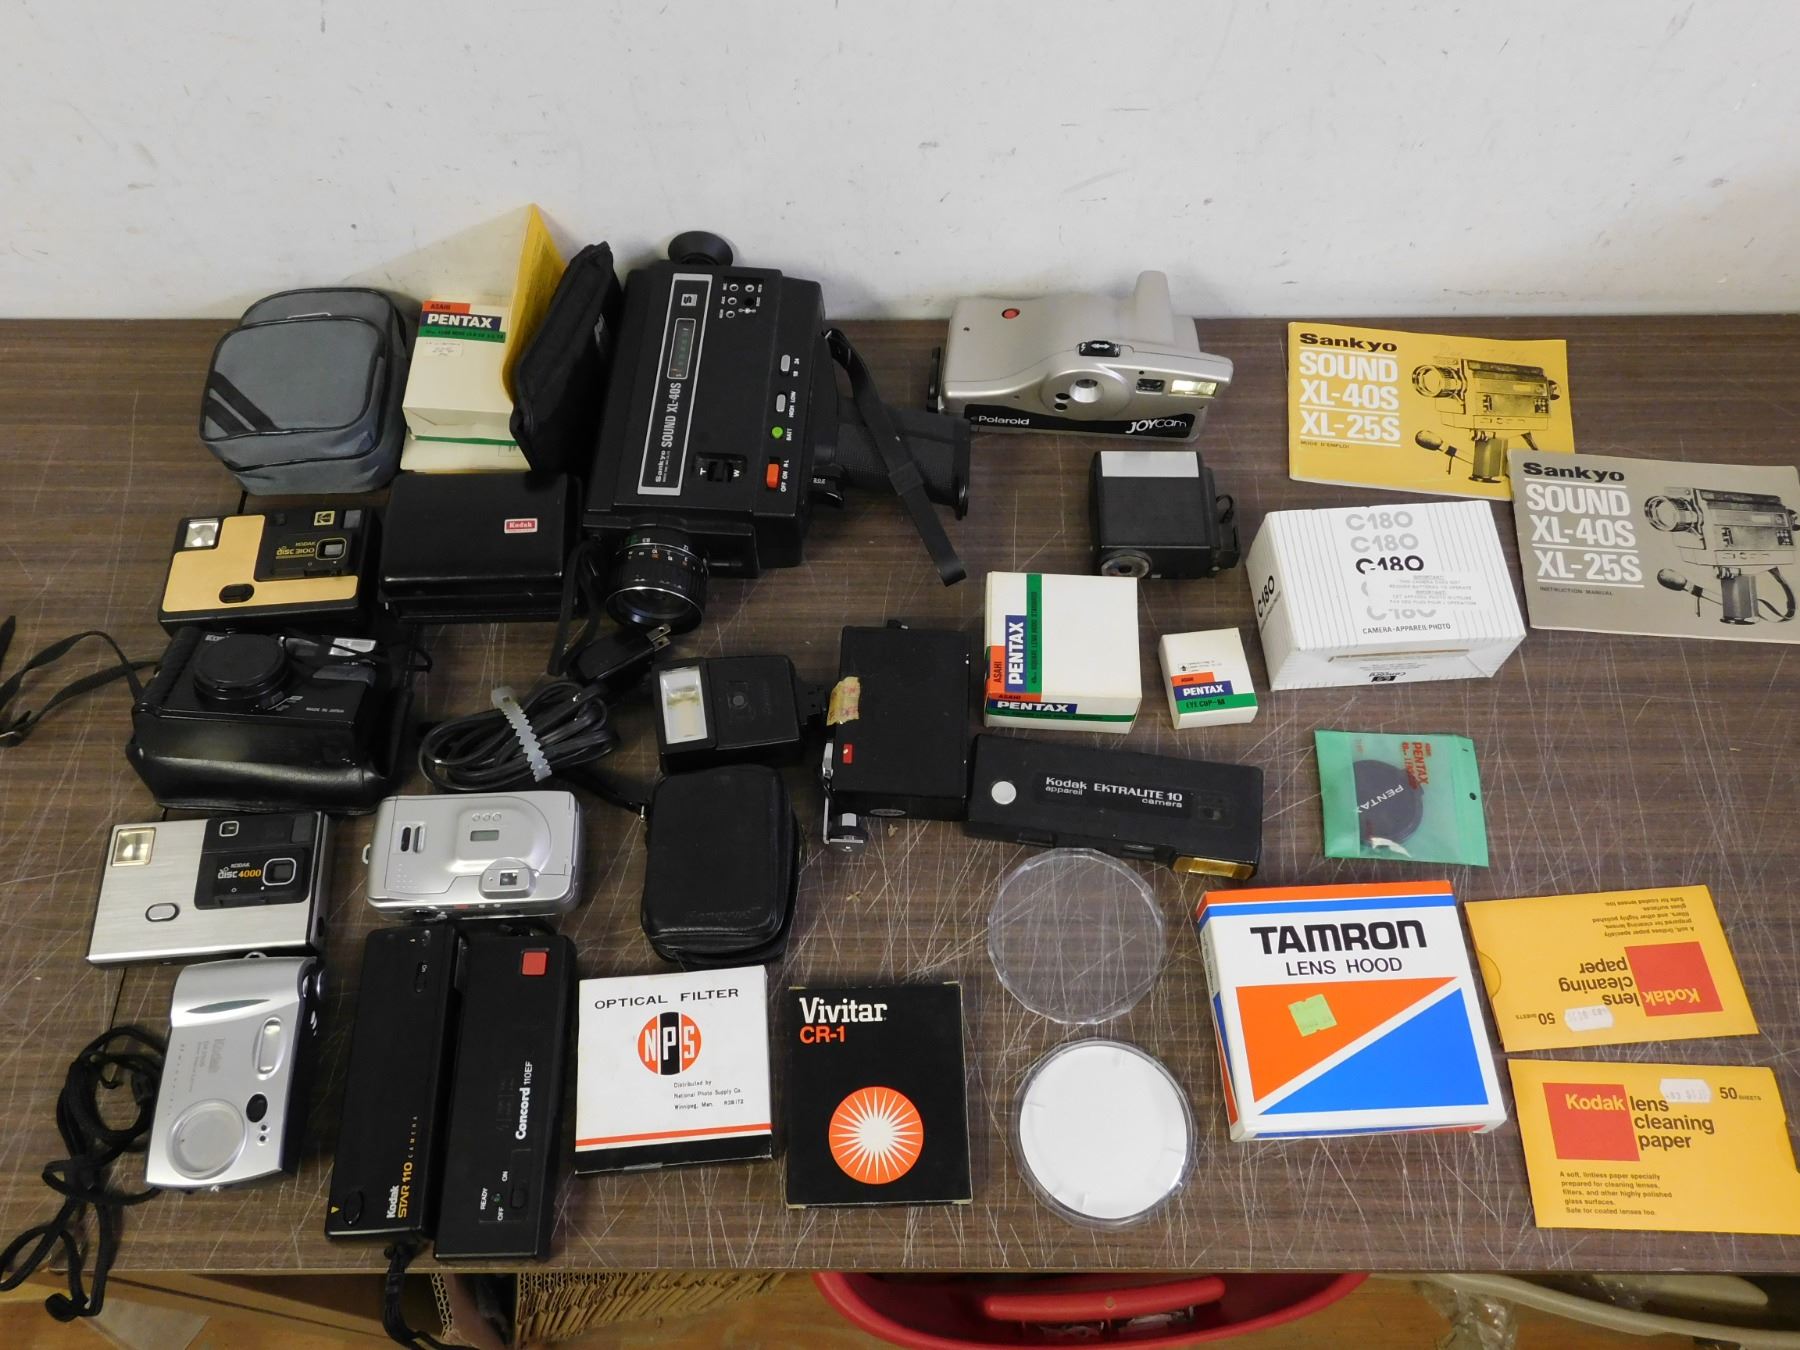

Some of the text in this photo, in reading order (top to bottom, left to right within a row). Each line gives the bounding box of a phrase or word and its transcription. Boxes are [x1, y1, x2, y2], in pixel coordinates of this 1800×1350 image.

[427, 313, 492, 328] PENTAX
[1299, 333, 1398, 352] Sankyo
[1299, 351, 1398, 383] SOUND
[666, 382, 682, 413] XL-40S
[1300, 378, 1399, 410] XL-40S
[978, 415, 1030, 426] Polaroid
[1300, 410, 1400, 441] XL-25S
[661, 415, 676, 448] SOUND
[655, 450, 666, 482] Sankyo
[733, 469, 740, 477] W
[782, 471, 788, 479] ON
[1523, 462, 1625, 482] Sankyo
[1526, 483, 1631, 516] SOUND
[509, 520, 532, 529] Kodak
[1345, 511, 1413, 531] C180
[1529, 514, 1636, 547] XL-40S
[1350, 533, 1419, 553] C180
[1355, 555, 1424, 575] C180
[1534, 550, 1642, 582] XL-25S
[1009, 622, 1023, 684] PENTAX
[994, 662, 1002, 683] ASAHI
[1183, 685, 1224, 697] PENTAX
[997, 701, 1068, 712] PENTAX
[1412, 742, 1430, 785] PENTAX
[1046, 776, 1183, 802] Kodak EKTRALITE 10
[1046, 785, 1182, 808] appareil camera
[239, 869, 261, 878] 4000
[1250, 920, 1427, 954] TAMRON
[1286, 957, 1402, 976] LENS HOOD
[1579, 957, 1628, 975] paper
[1558, 977, 1634, 994] cleaning
[594, 988, 739, 1009] OPTICAL FILTER
[1602, 988, 1700, 1007] Kodak lens
[800, 998, 888, 1023] Vivitar
[1538, 1012, 1556, 1025] 50
[644, 1025, 694, 1062] NPS
[800, 1026, 845, 1044] CR-1
[516, 1060, 533, 1140] Concord 110EF
[1565, 1094, 1669, 1112] Kodak lens
[1719, 1087, 1738, 1100] 50
[1634, 1114, 1715, 1134] cleaning
[1638, 1133, 1692, 1152] paper
[402, 1162, 413, 1182] 110
[502, 1171, 508, 1182] ON
[1630, 1173, 1660, 1181] specially
[386, 1185, 399, 1218] Kodak
[398, 1185, 410, 1218] STAR
[480, 1188, 488, 1210] READY
